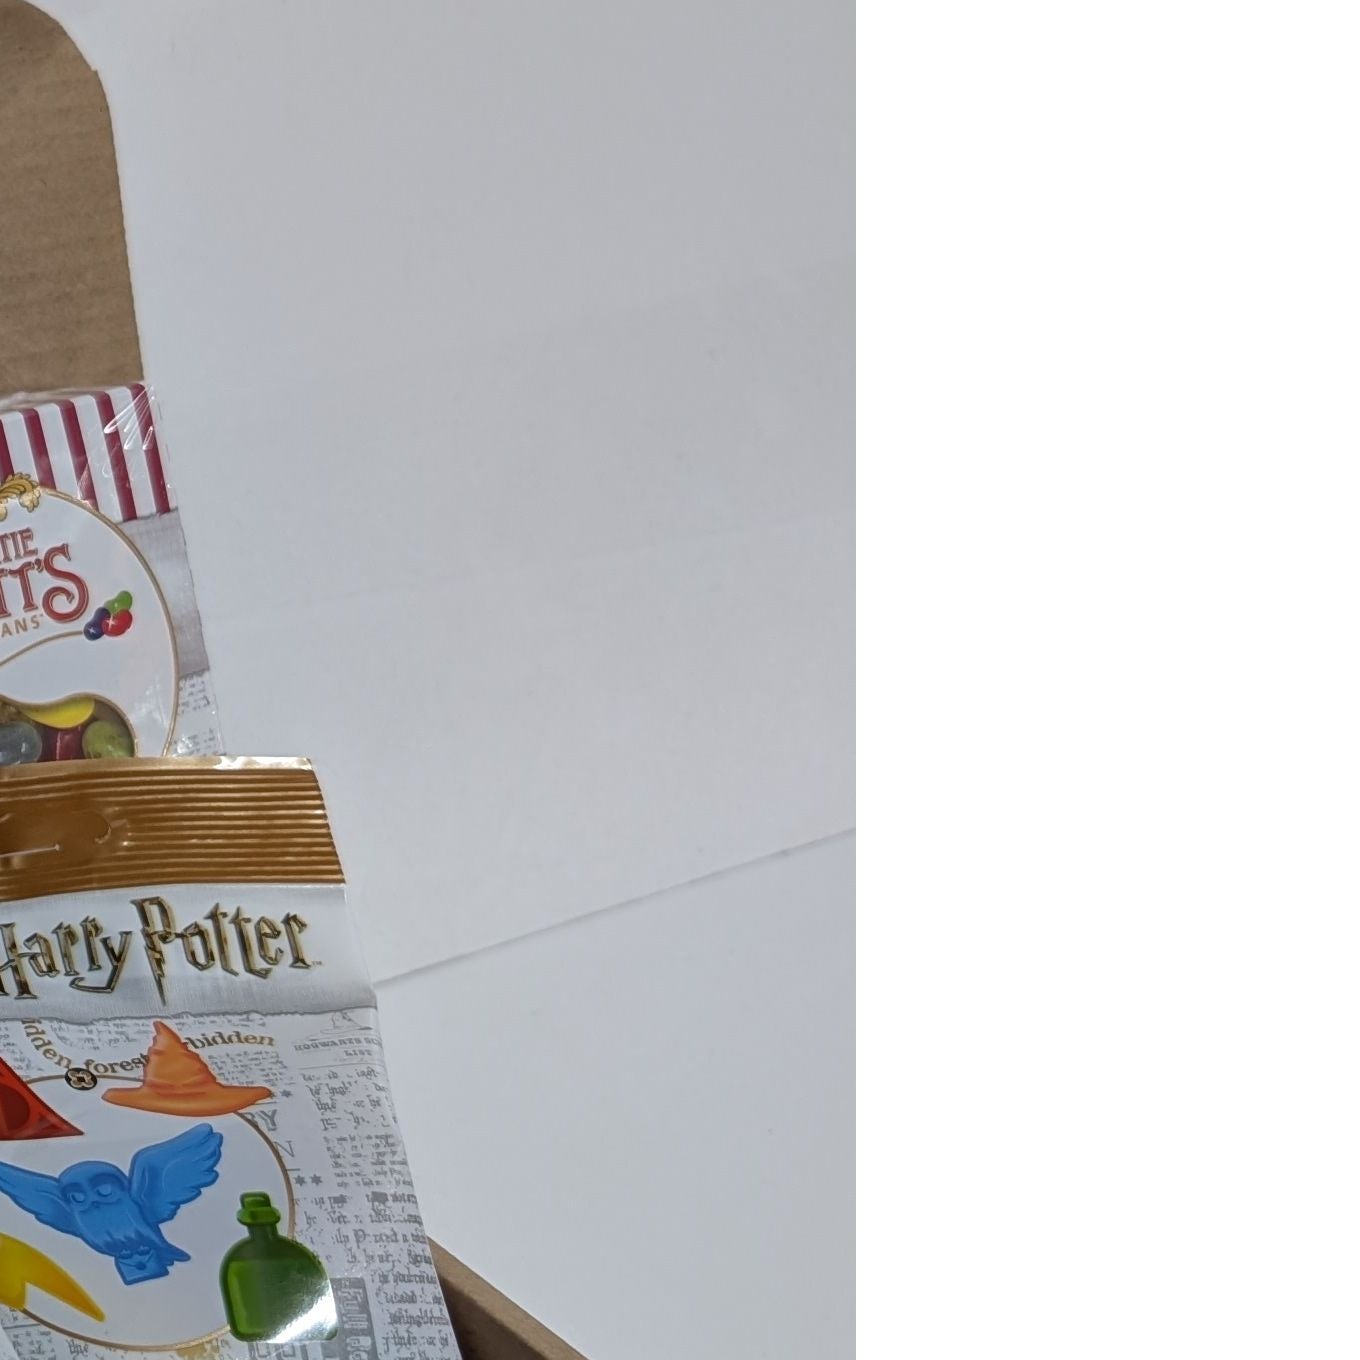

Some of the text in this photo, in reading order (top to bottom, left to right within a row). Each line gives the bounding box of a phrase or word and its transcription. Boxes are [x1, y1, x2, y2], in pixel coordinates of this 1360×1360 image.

[129, 895, 310, 1007] Potter
[83, 1052, 150, 1074] forest
[184, 1030, 275, 1047] bidden
